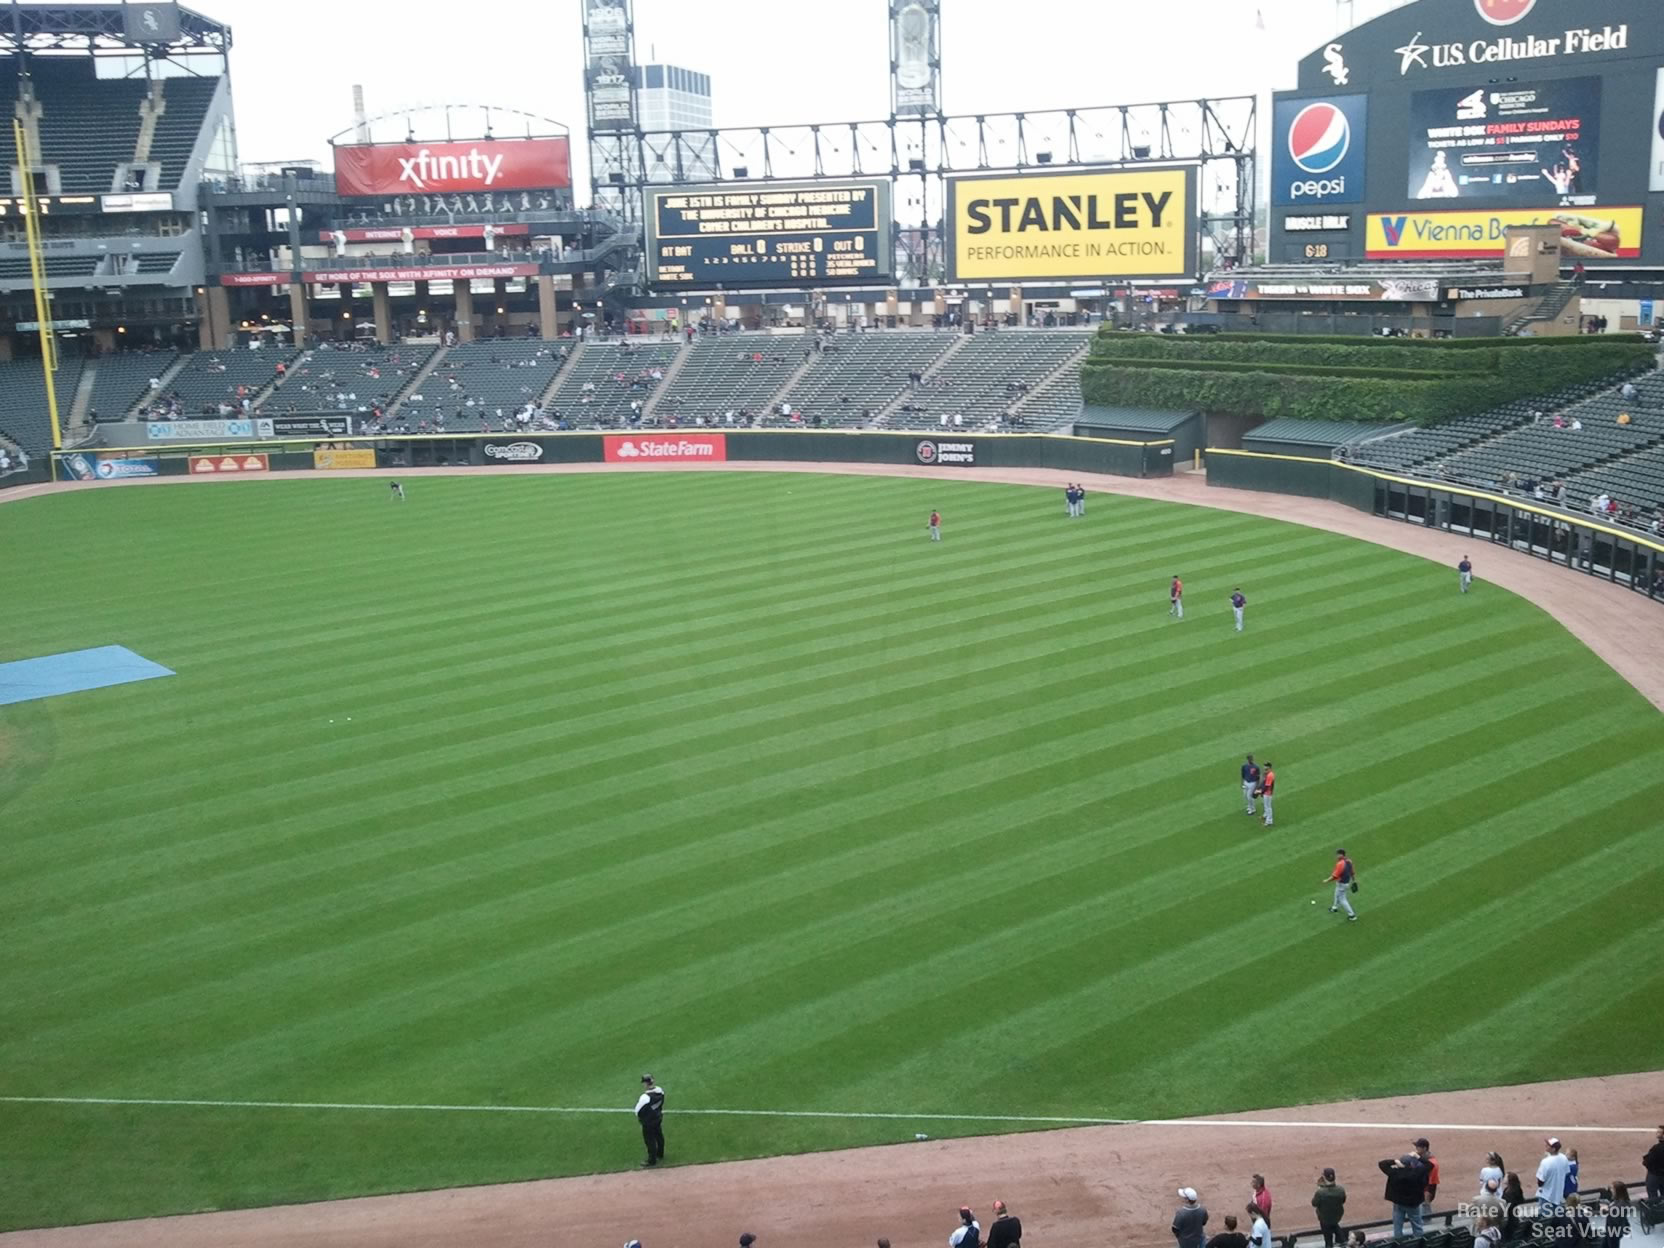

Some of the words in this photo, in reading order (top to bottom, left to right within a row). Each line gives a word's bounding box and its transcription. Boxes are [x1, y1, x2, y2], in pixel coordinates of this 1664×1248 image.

[1469, 35, 1560, 64] Cellular
[1563, 25, 1628, 54] Field
[1427, 127, 1463, 139] WHITE
[1464, 125, 1486, 137] SOX
[1487, 123, 1527, 135] FAMILY
[1527, 119, 1580, 132] SUNDAYS
[1467, 138, 1484, 146] LOW
[1543, 134, 1565, 142] ONLY
[1565, 133, 1579, 141] $10
[397, 148, 504, 188] xfinity
[1290, 175, 1345, 199] pepsi
[664, 197, 689, 209] JUNE
[713, 195, 724, 207] IS
[724, 194, 759, 206] FAMILY
[760, 193, 797, 205] SUNDAY
[797, 190, 851, 203] PRESENTED
[851, 190, 866, 202] BY
[680, 210, 699, 221] THE
[700, 207, 753, 220] UNIVERSITY
[754, 207, 767, 218] OF
[768, 206, 807, 217] CHICAGO
[808, 204, 851, 216] MEDICINE
[967, 191, 1173, 235] STANLEY
[699, 221, 730, 233] COMER
[731, 218, 783, 232] CHILDREN'S
[1285, 216, 1322, 230] MUSCLE
[1322, 215, 1349, 229] MILK
[1412, 219, 1484, 241] Vienna
[433, 228, 459, 236] VOICE
[661, 246, 674, 257] AT
[730, 244, 755, 255] BALL
[756, 239, 766, 254] 0
[776, 242, 811, 254] STRIKE
[813, 237, 823, 252] 0
[833, 240, 853, 252] OUT
[854, 235, 865, 251] 0
[968, 244, 1080, 260] PERFORMANCE
[1086, 243, 1101, 257] IN
[1106, 241, 1165, 256] ACTION
[732, 256, 740, 264] 4
[315, 273, 328, 281] GET
[349, 272, 361, 280] OF
[379, 271, 397, 279] SOX
[397, 270, 421, 278] WITH
[422, 269, 458, 277] XFINITY
[460, 268, 475, 276] ON
[476, 267, 515, 275] DEMAND
[1257, 285, 1297, 294] TIGERS
[1309, 285, 1345, 294] WHITE
[1345, 285, 1371, 295] SOX
[1460, 289, 1475, 299] The
[1475, 287, 1523, 298] PrivateBank
[937, 443, 974, 453] JIMMY
[937, 453, 974, 463] JOHN'S
[114, 465, 153, 473] TOTAL
